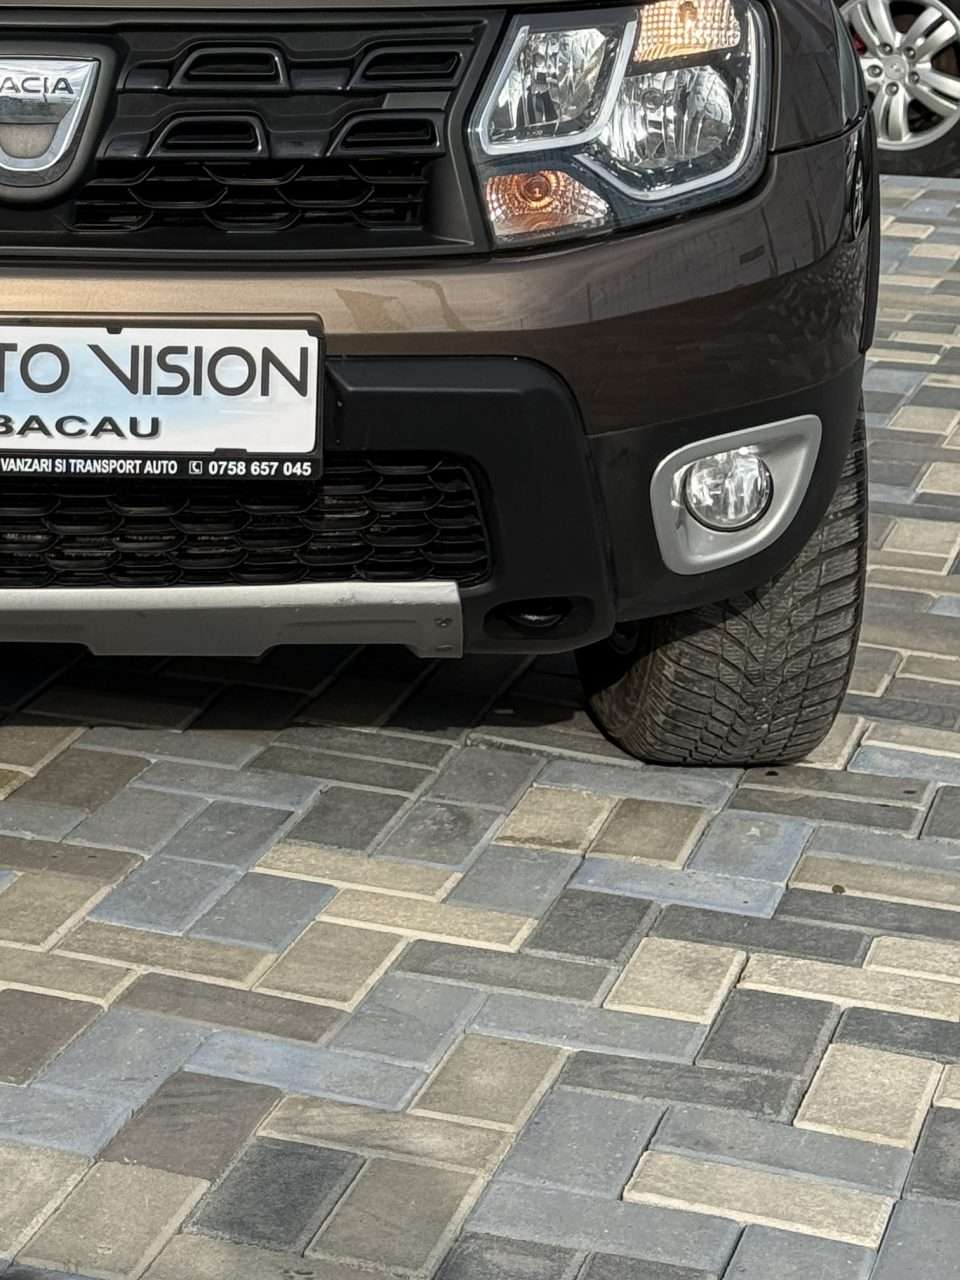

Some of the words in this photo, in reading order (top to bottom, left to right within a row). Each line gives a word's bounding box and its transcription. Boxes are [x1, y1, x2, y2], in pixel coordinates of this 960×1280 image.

[87, 344, 309, 397] VISION
[0, 458, 52, 473] VANZARI
[55, 458, 66, 473] SI
[69, 459, 142, 474] TRANSPORT
[144, 460, 178, 474] AUTO
[208, 461, 246, 475] 0758
[251, 462, 279, 476] 657
[283, 462, 312, 476] 045
